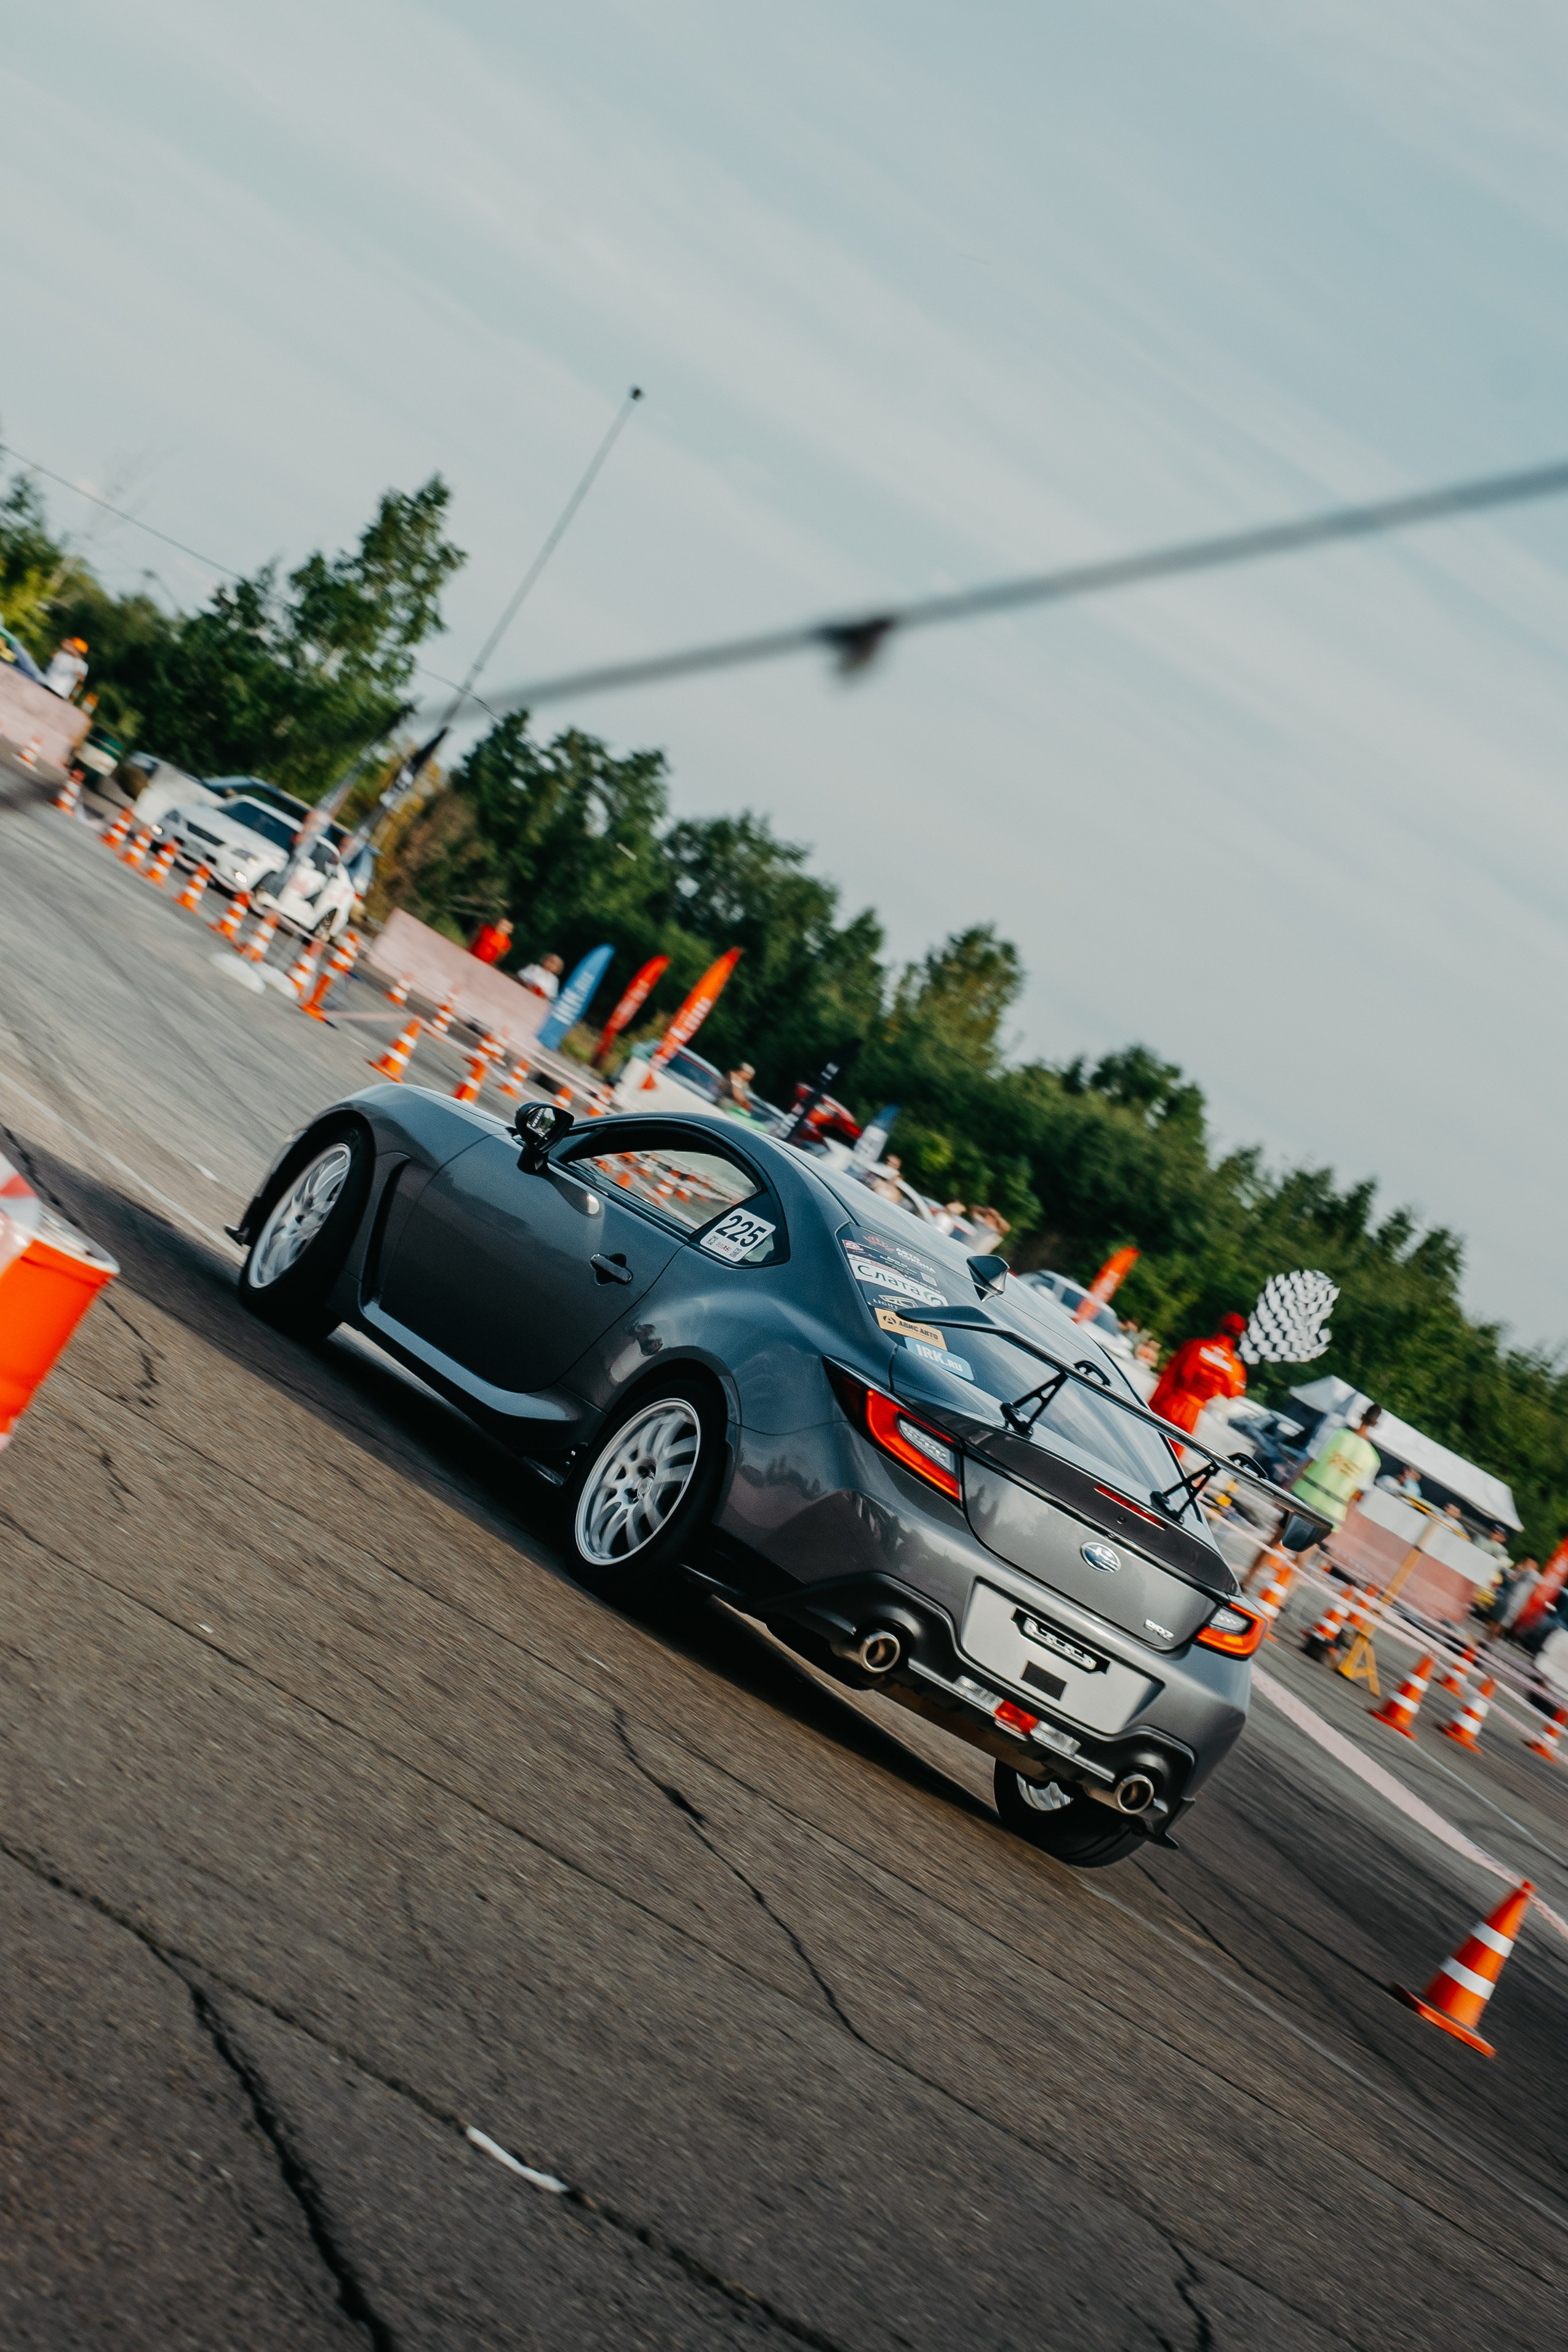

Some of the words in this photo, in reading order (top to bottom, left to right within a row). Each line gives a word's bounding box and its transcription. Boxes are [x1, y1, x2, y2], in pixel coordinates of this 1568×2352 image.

[714, 1215, 767, 1248] 225
[858, 1265, 921, 1296] Слата
[920, 1328, 939, 1340] АВТО
[916, 1343, 963, 1372] IRK.RU
